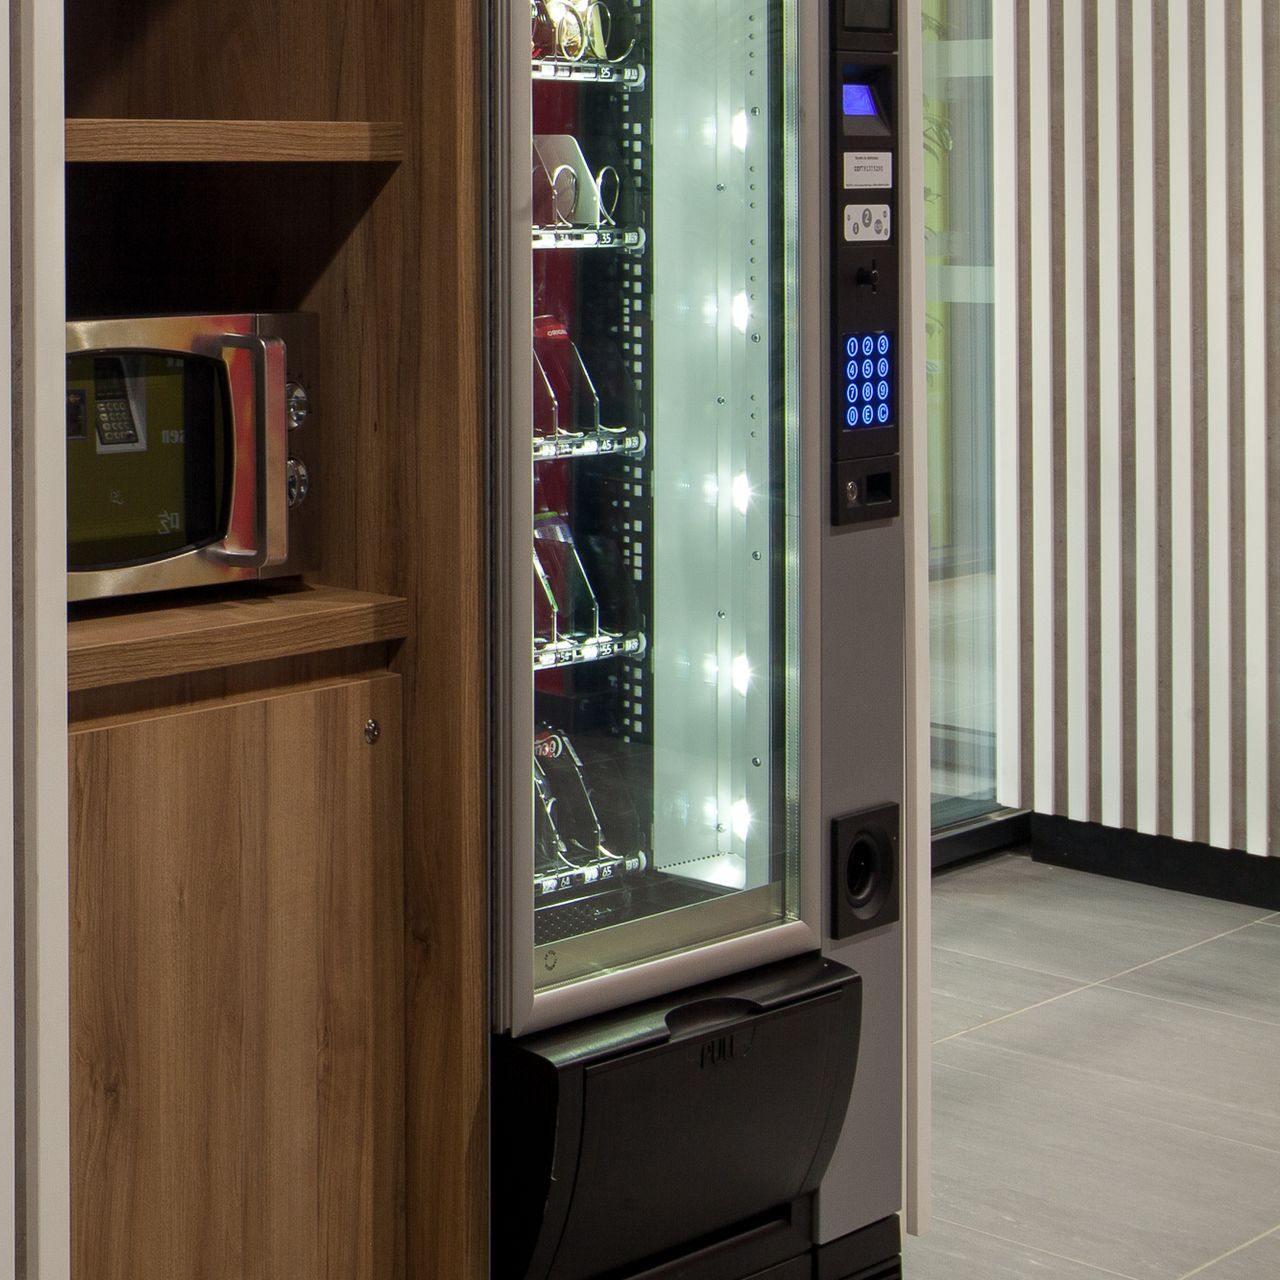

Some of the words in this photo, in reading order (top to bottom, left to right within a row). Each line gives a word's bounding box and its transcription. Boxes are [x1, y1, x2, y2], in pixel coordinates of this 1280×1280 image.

[601, 67, 611, 78] 25
[601, 233, 611, 244] 35
[601, 440, 611, 450] 45
[601, 644, 612, 656] 55
[561, 877, 570, 887] 64
[602, 866, 612, 877] 65
[700, 1034, 735, 1069] PULL
